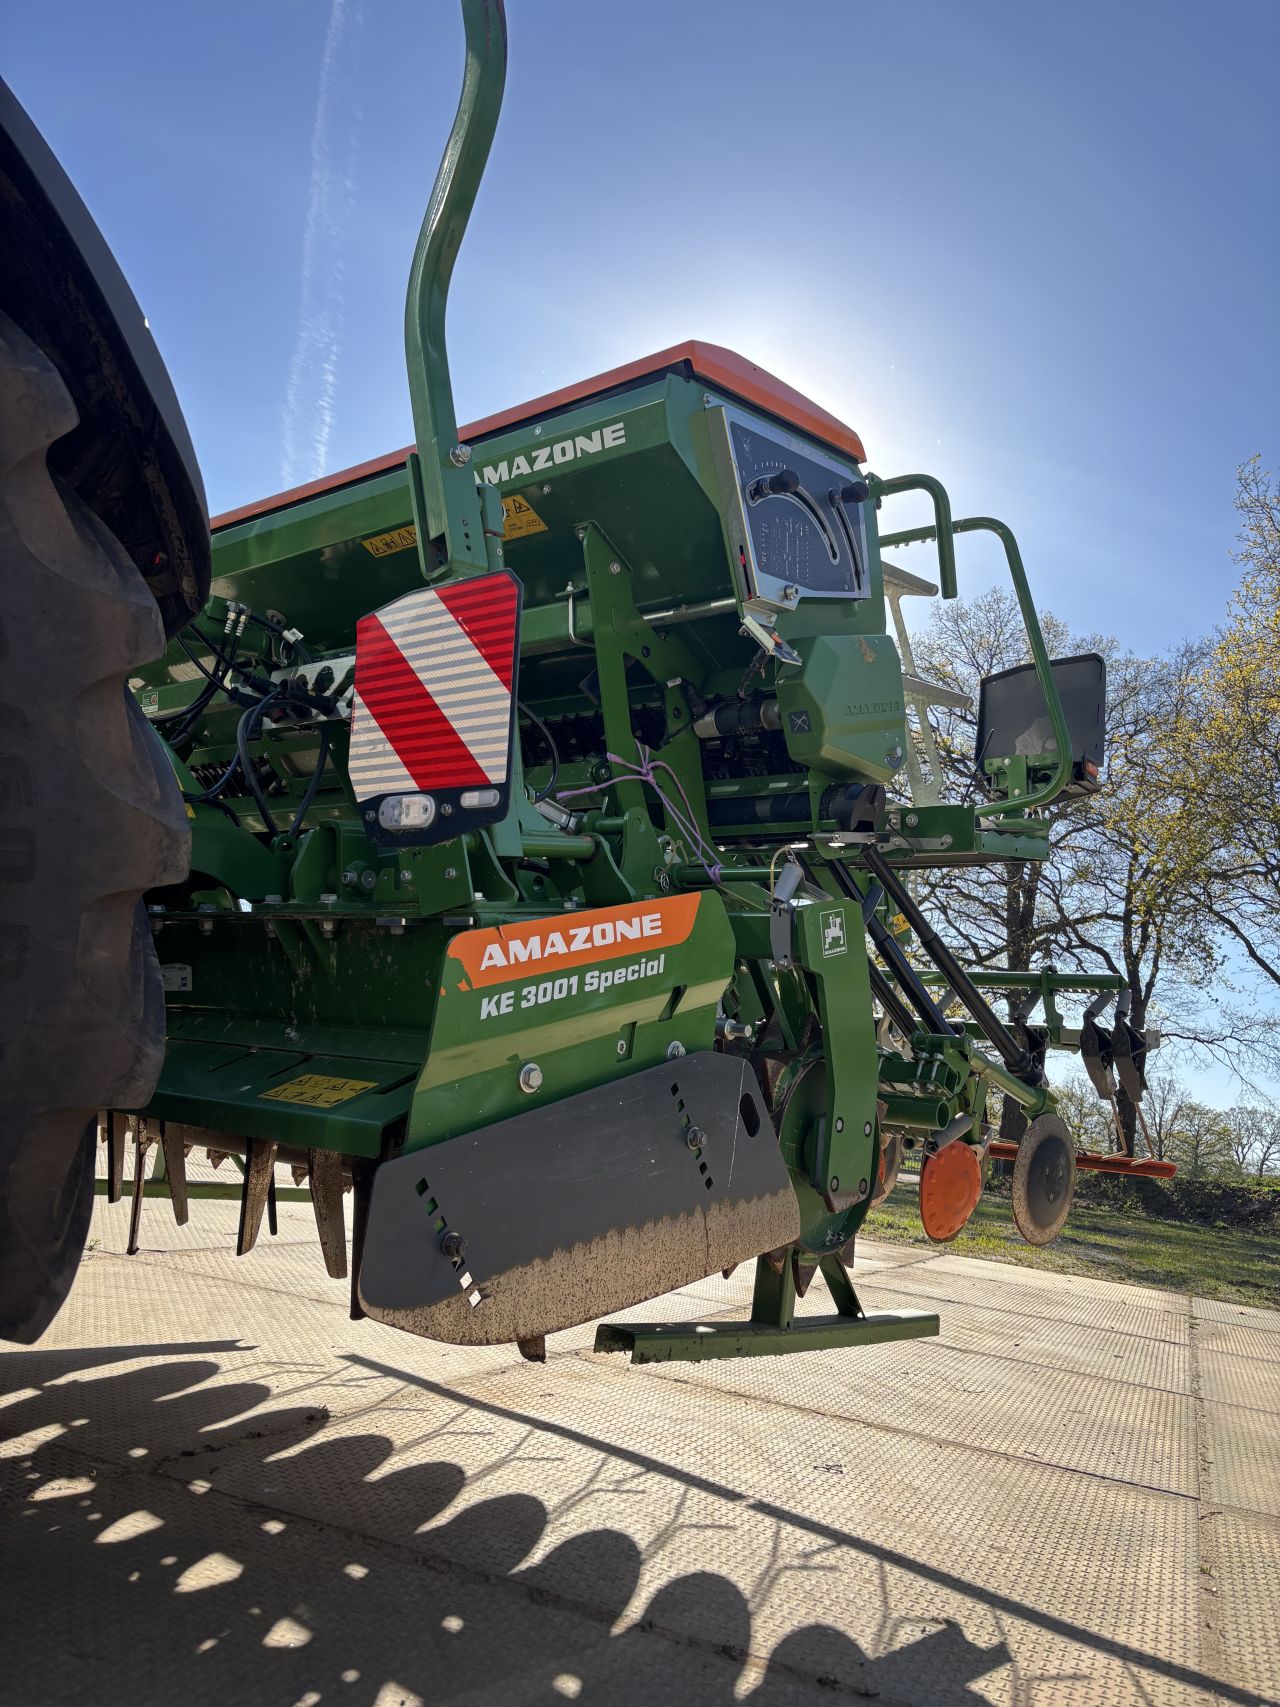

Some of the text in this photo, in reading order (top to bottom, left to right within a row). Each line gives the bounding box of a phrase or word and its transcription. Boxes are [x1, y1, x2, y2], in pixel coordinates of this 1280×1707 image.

[480, 913, 662, 970] AMAZONE
[480, 953, 665, 1020] KE 3001 Special
